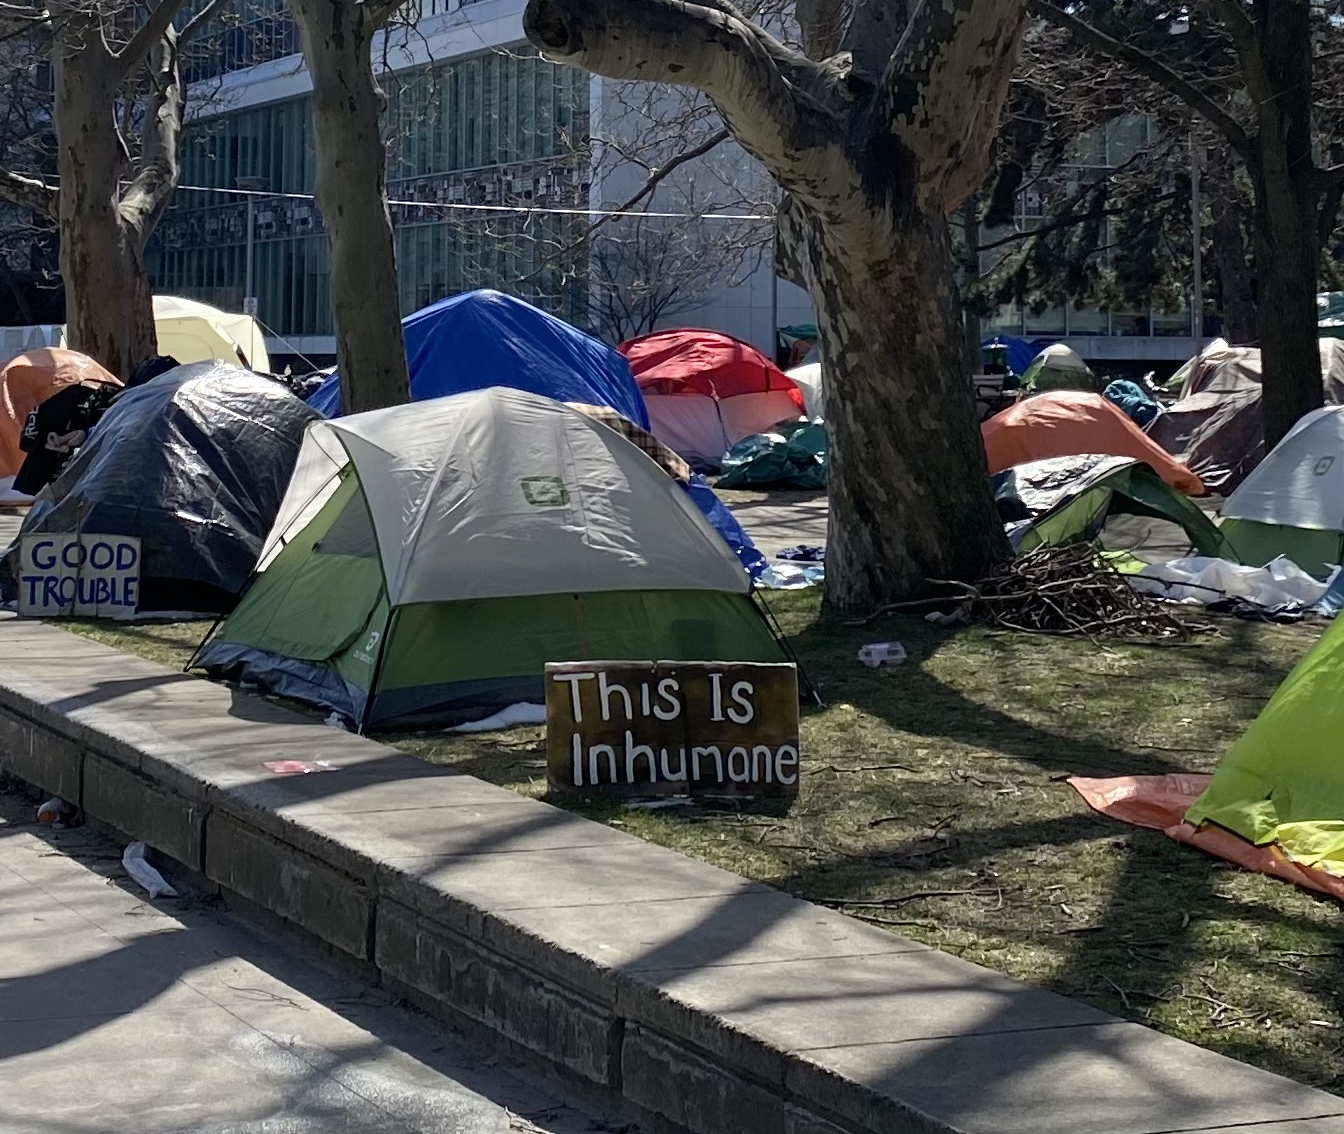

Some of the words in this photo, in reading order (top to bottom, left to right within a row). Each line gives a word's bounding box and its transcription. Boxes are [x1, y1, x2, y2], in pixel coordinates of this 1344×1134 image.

[31, 541, 138, 571] GOOD
[21, 575, 139, 608] TROUBLE
[552, 668, 682, 723] This
[708, 672, 755, 725] Is
[572, 729, 798, 786] Inhumane
